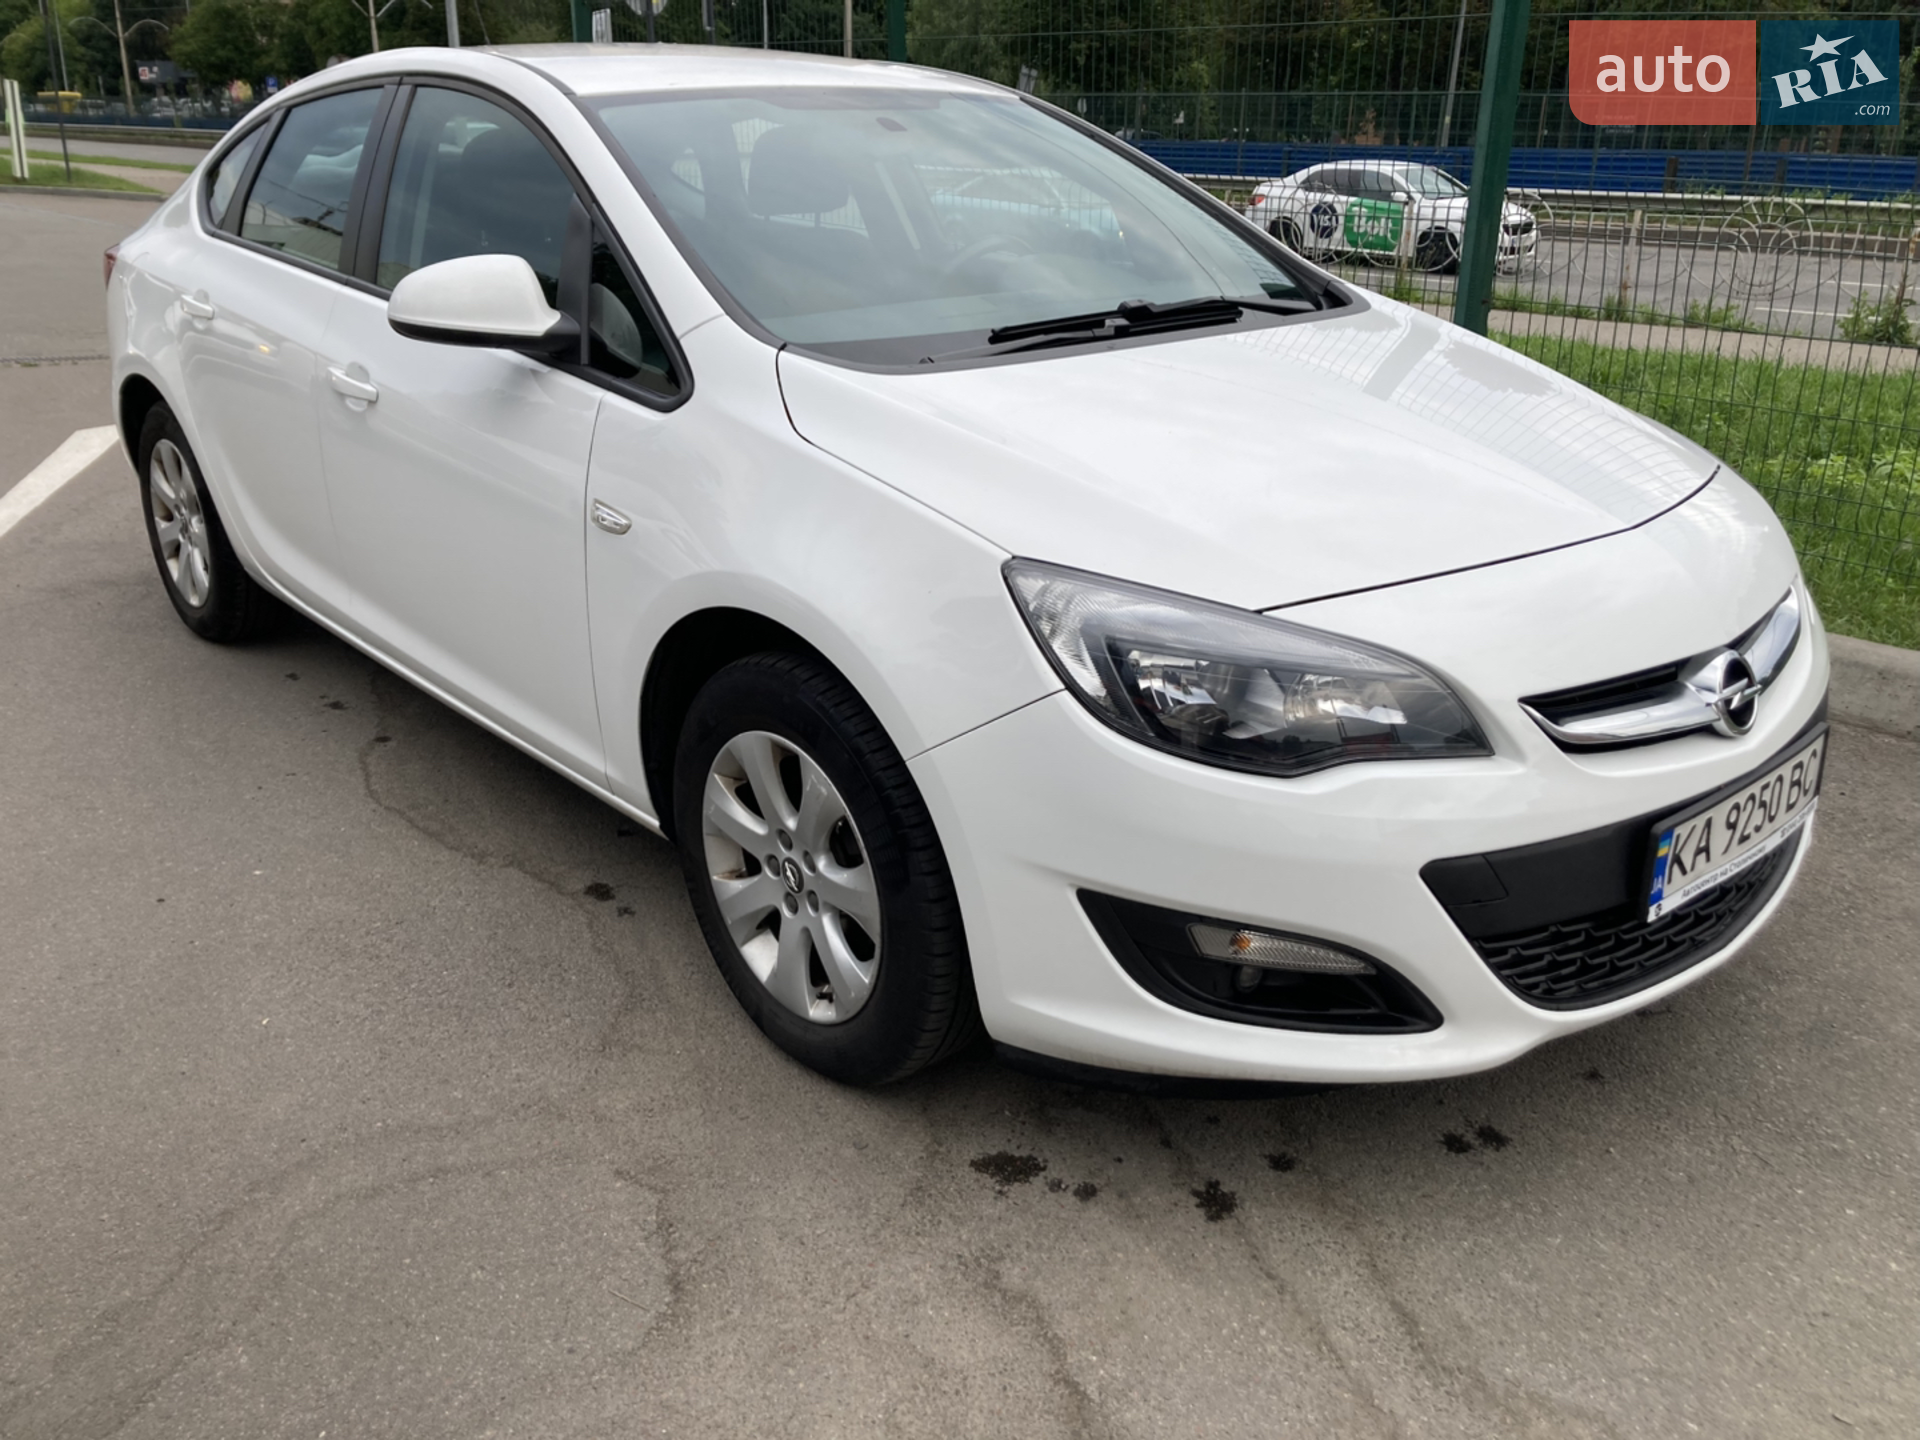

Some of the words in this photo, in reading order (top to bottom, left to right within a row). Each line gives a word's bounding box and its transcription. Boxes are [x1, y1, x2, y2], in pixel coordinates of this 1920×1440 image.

[1351, 207, 1392, 237] Bolt
[1667, 816, 1713, 885] KA
[1722, 774, 1783, 855] 9250
[1786, 749, 1817, 814] BC
[1681, 873, 1719, 899] Автоцентр
